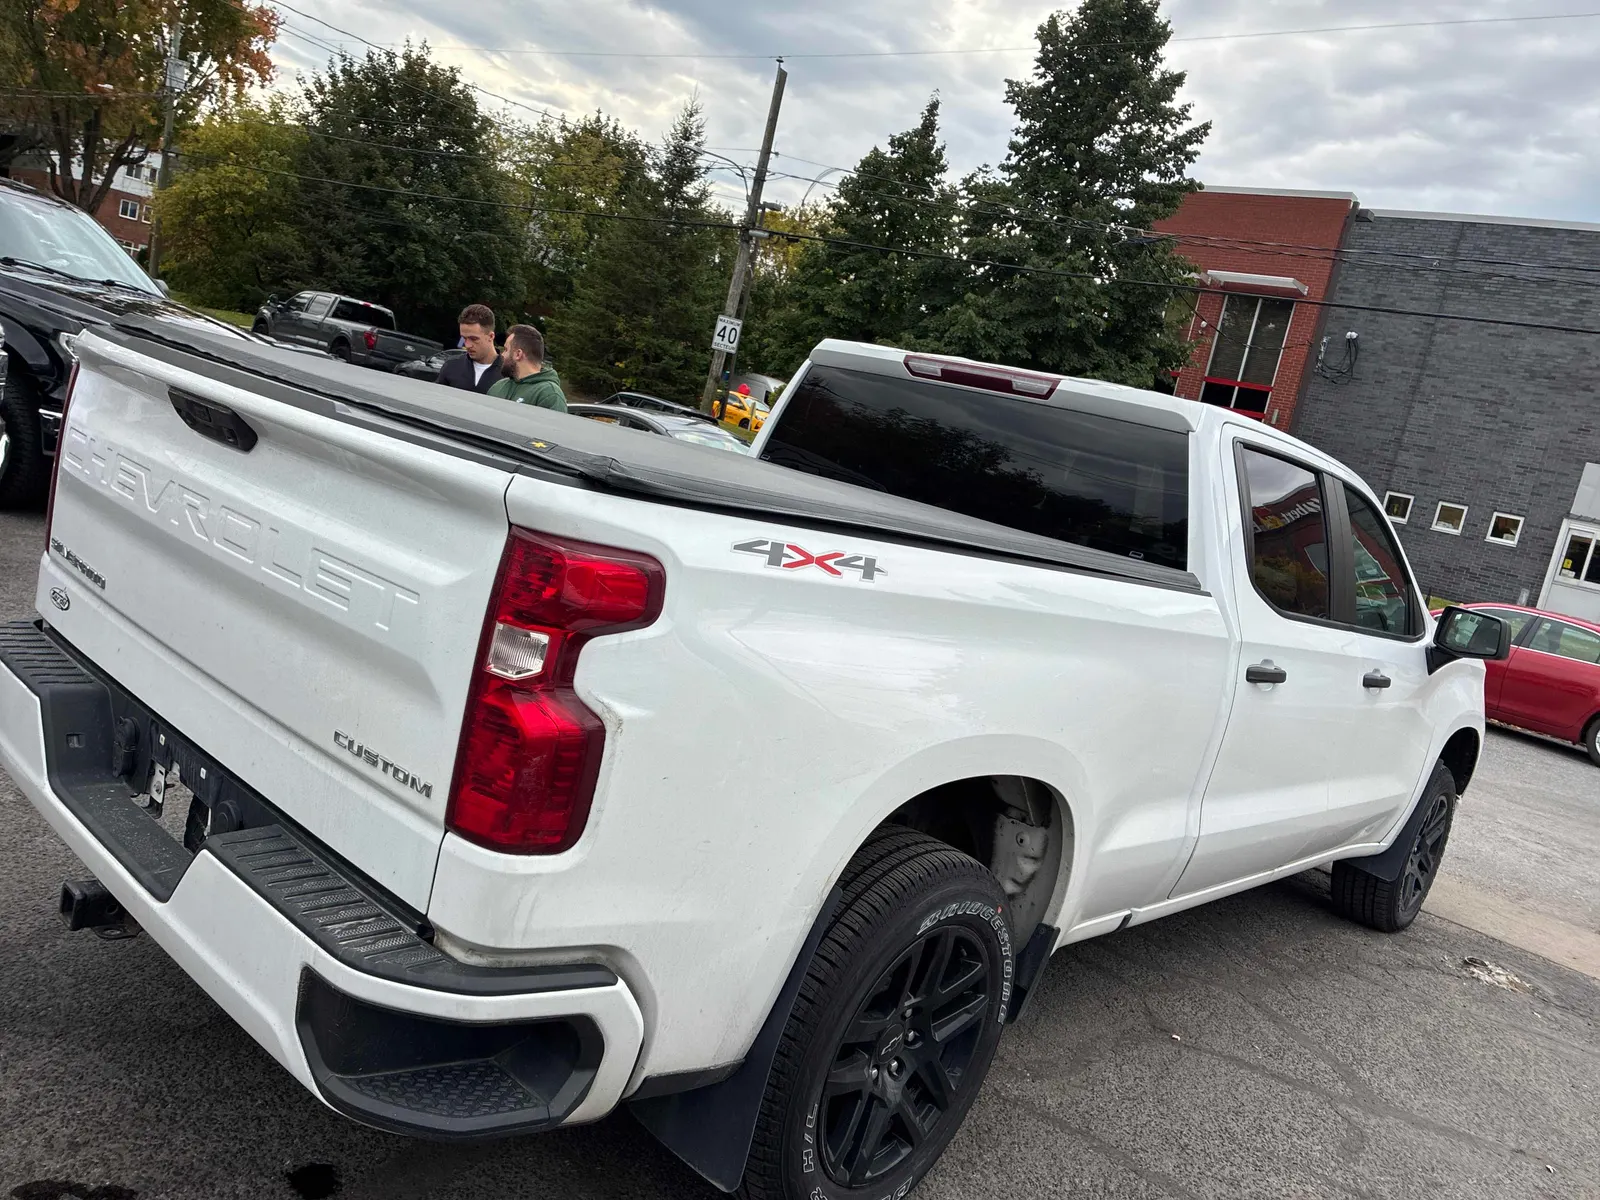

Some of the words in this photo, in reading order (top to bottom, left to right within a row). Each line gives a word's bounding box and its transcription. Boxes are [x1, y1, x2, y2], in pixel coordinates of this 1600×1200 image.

[717, 325, 738, 344] 40
[719, 318, 741, 327] MAXIMUM
[713, 342, 736, 351] SECTEUR
[61, 427, 421, 631] CHEVROLET
[333, 728, 434, 799] CUSTOM
[916, 901, 1013, 1026] BRIDGESTONE
